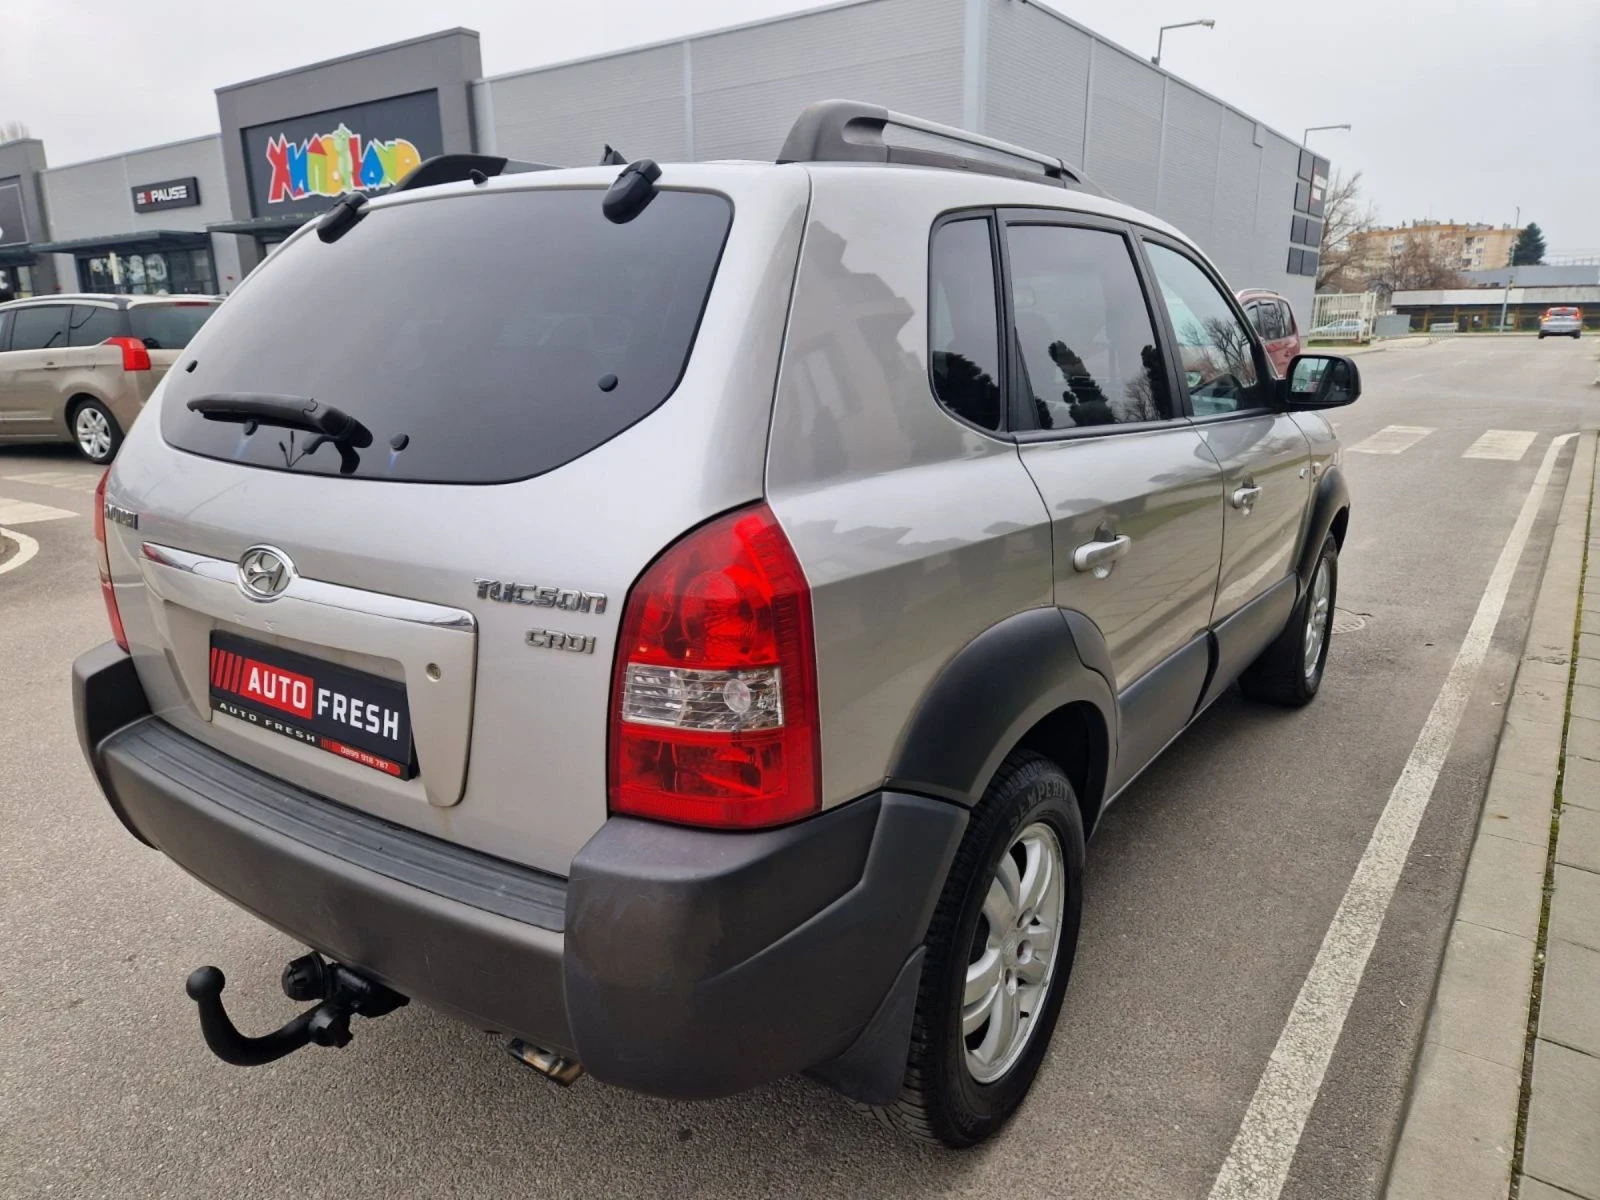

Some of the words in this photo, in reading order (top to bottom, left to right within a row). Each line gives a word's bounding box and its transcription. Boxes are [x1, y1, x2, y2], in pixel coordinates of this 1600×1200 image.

[473, 577, 607, 614] TUCSON
[219, 702, 258, 722] AUTO
[265, 718, 316, 743] FRESH
[248, 667, 307, 710] AUTO
[317, 687, 400, 741] FRESH
